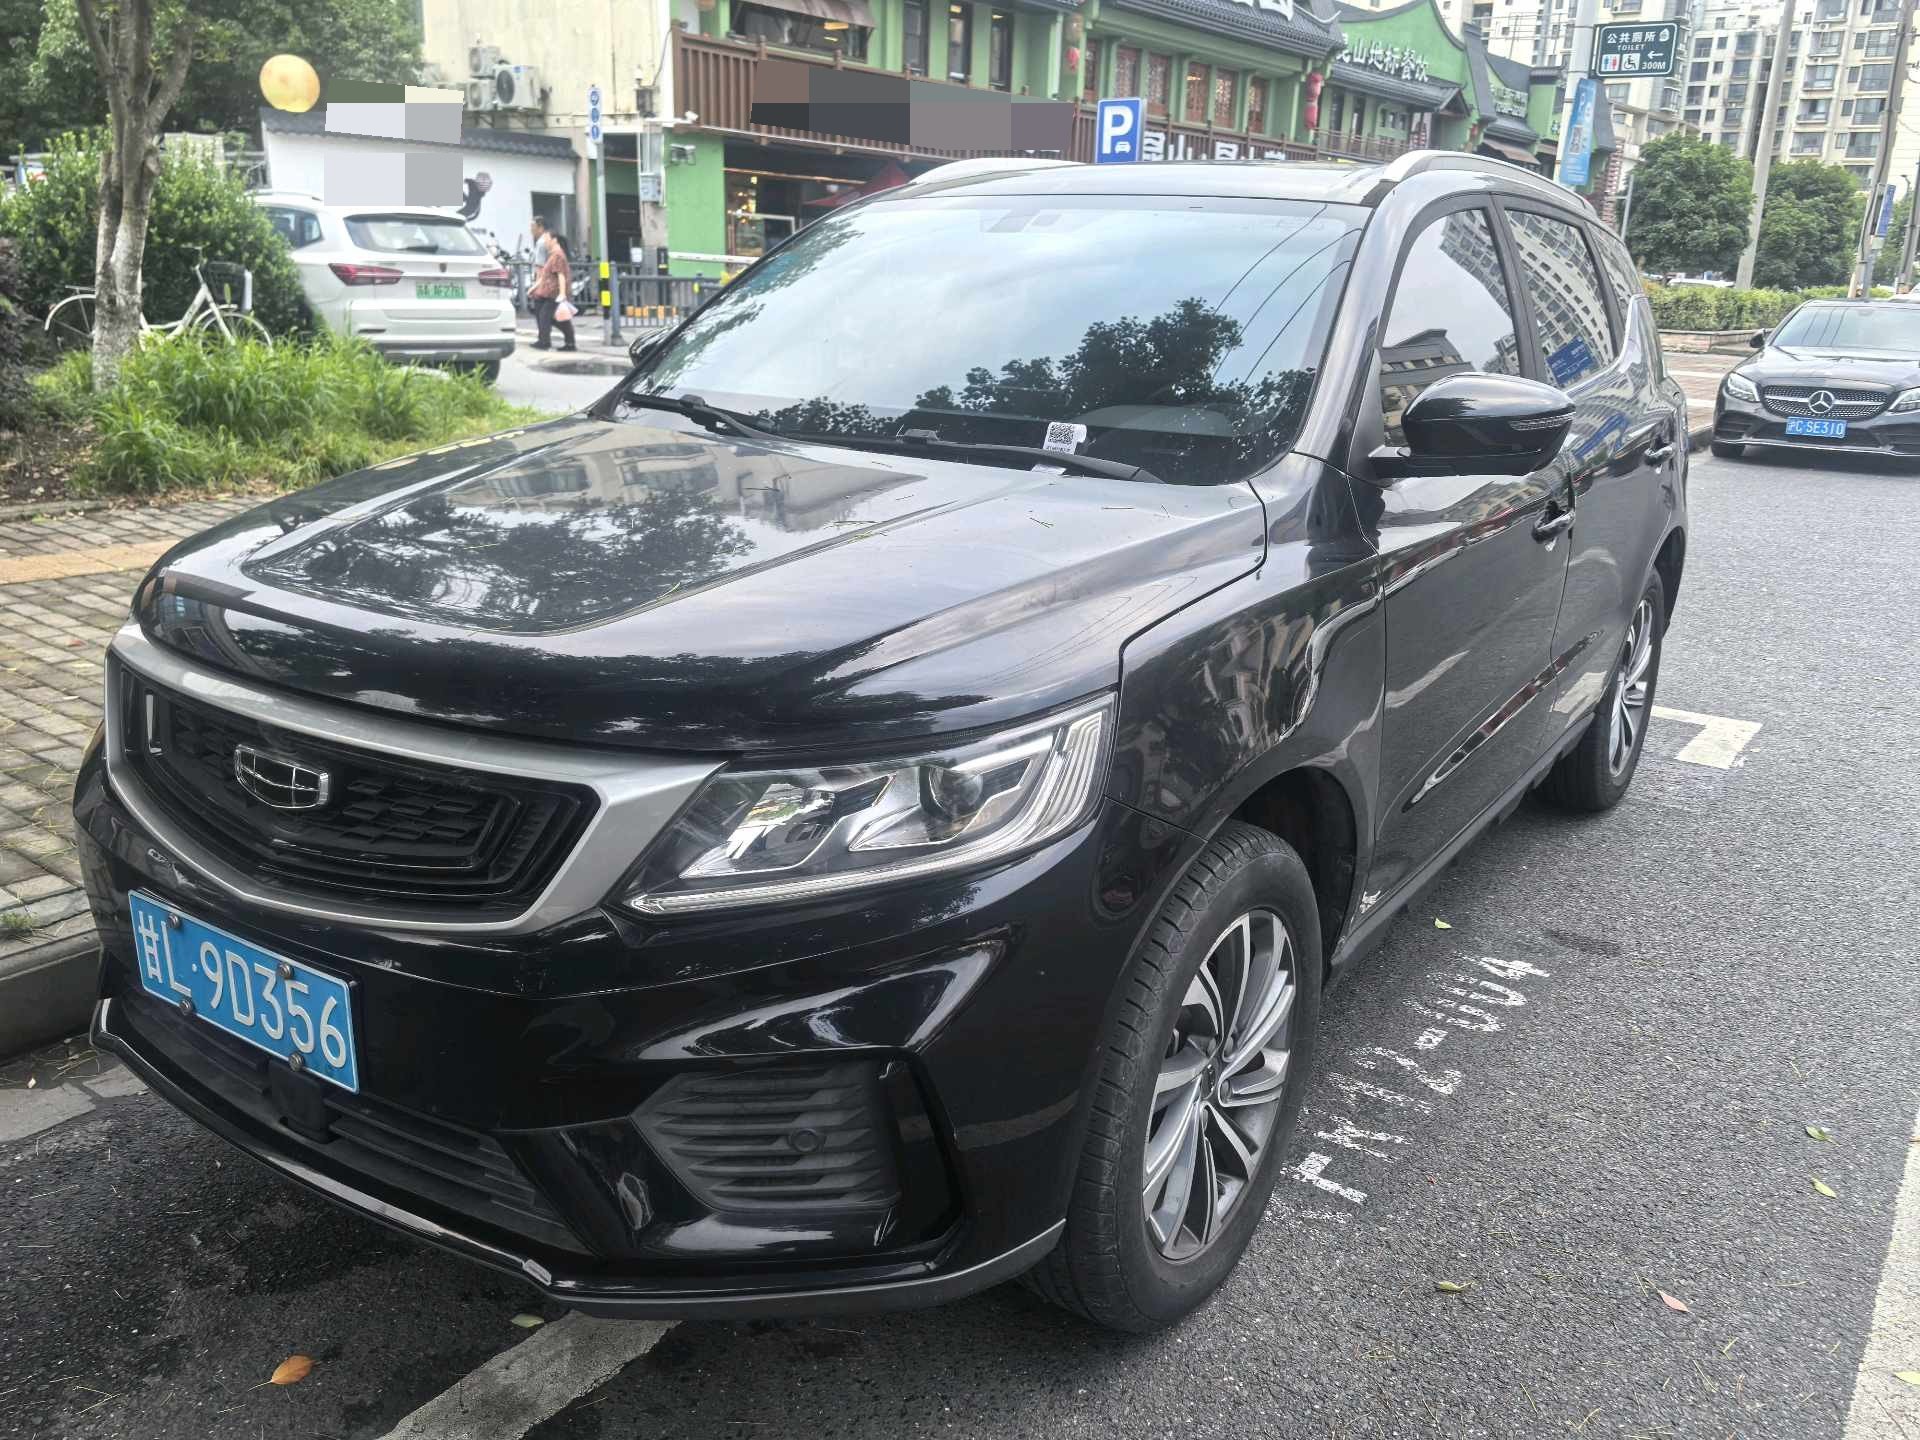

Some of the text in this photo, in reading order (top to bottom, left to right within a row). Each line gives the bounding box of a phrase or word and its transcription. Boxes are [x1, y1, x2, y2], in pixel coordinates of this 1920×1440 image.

[1607, 31, 1656, 44] 公共厕所
[1641, 61, 1666, 70] 300M
[1102, 105, 1134, 154] P
